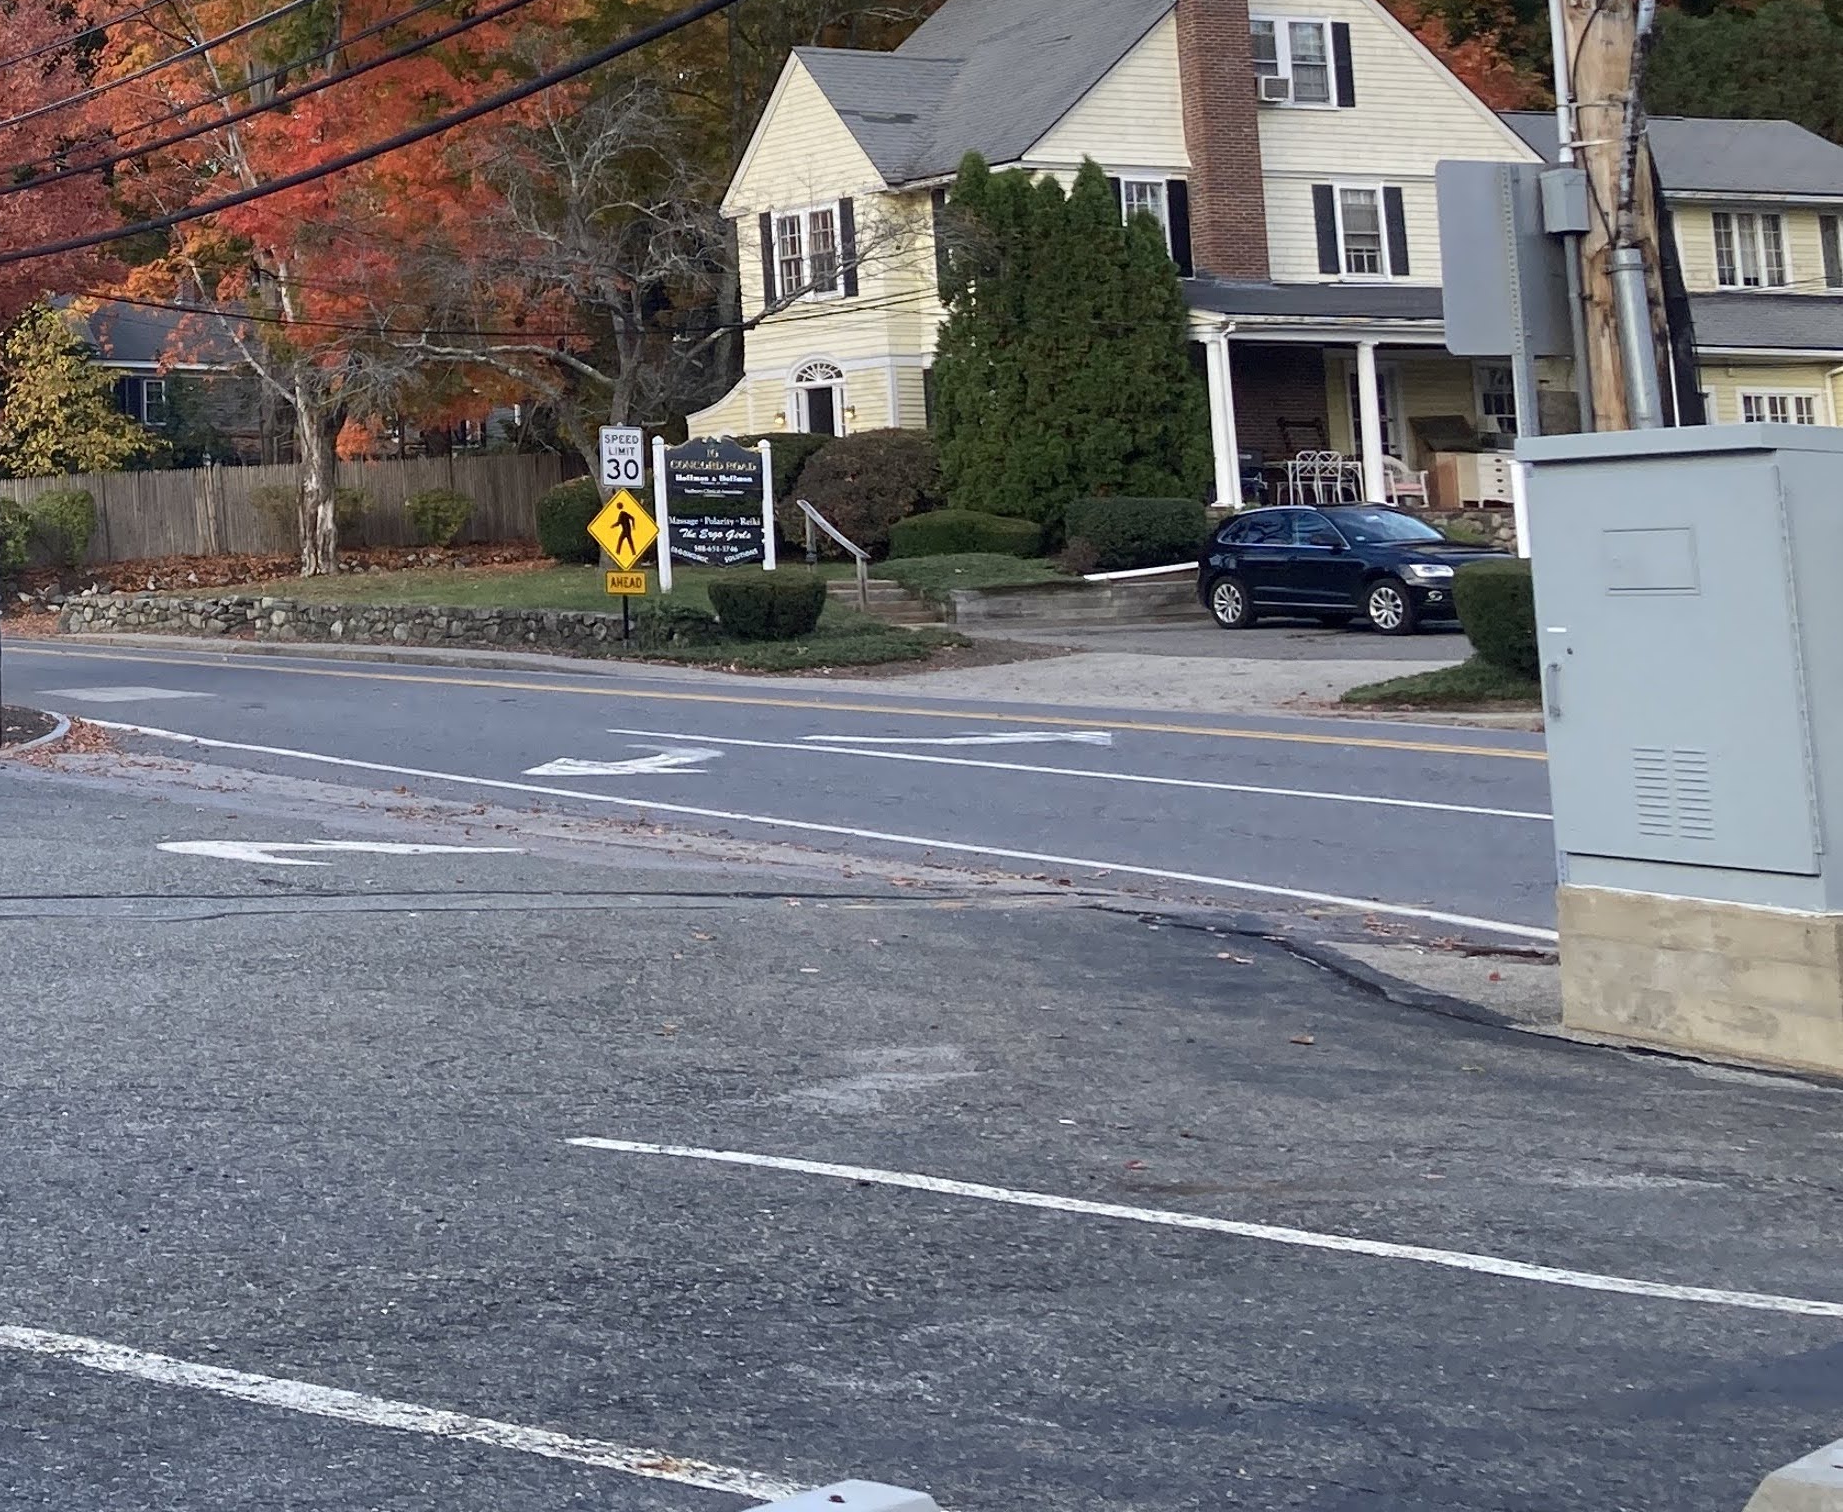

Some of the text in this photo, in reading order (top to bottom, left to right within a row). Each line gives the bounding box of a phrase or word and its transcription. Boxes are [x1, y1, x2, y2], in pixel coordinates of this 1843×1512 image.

[604, 434, 639, 444] SPEED
[608, 447, 635, 456] LIMIT
[607, 458, 639, 480] 30
[668, 516, 761, 526] Massage Polarity Reiki
[679, 528, 752, 541] The Ergo Girls
[610, 575, 642, 588] AHEAD
